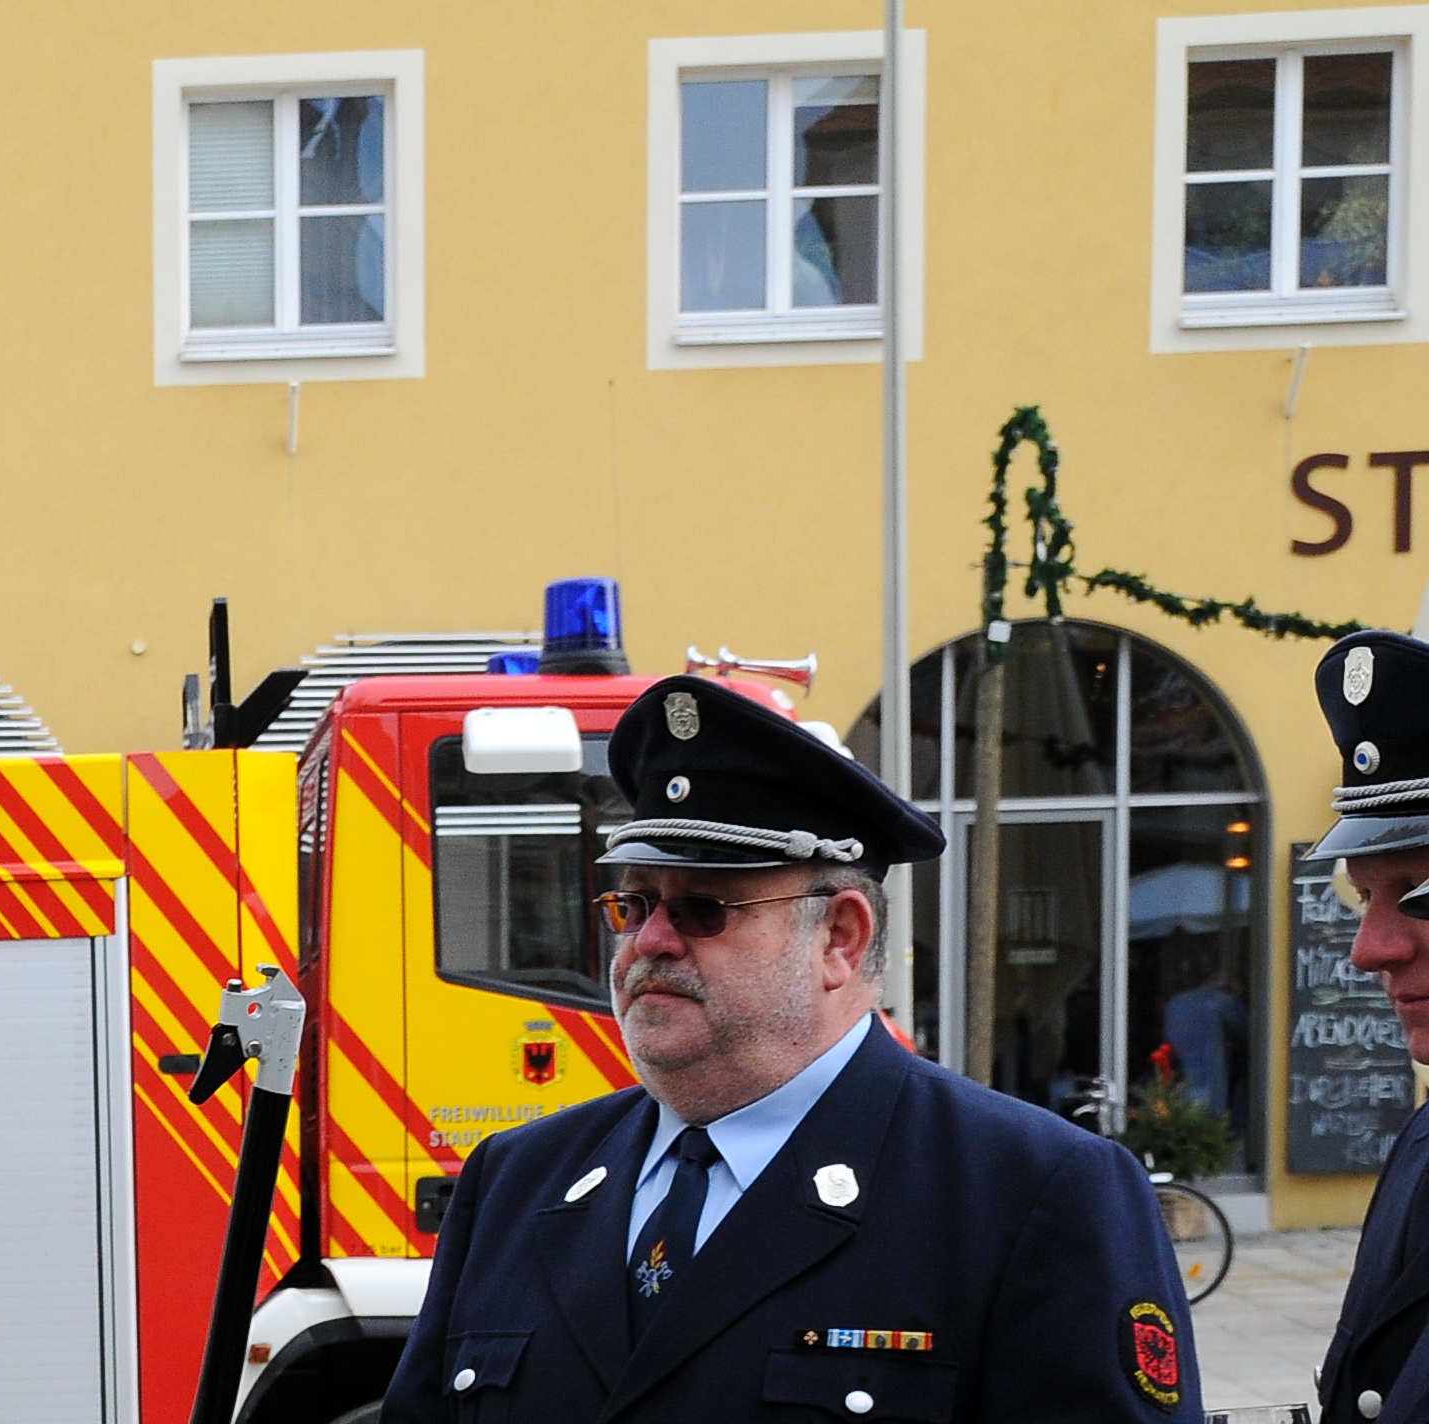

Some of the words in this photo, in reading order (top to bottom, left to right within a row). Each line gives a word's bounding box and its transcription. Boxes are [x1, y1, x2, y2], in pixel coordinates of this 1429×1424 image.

[1292, 451, 1429, 556] ST
[430, 1104, 544, 1123] FREIWILLIGE
[429, 1131, 482, 1148] STADT
